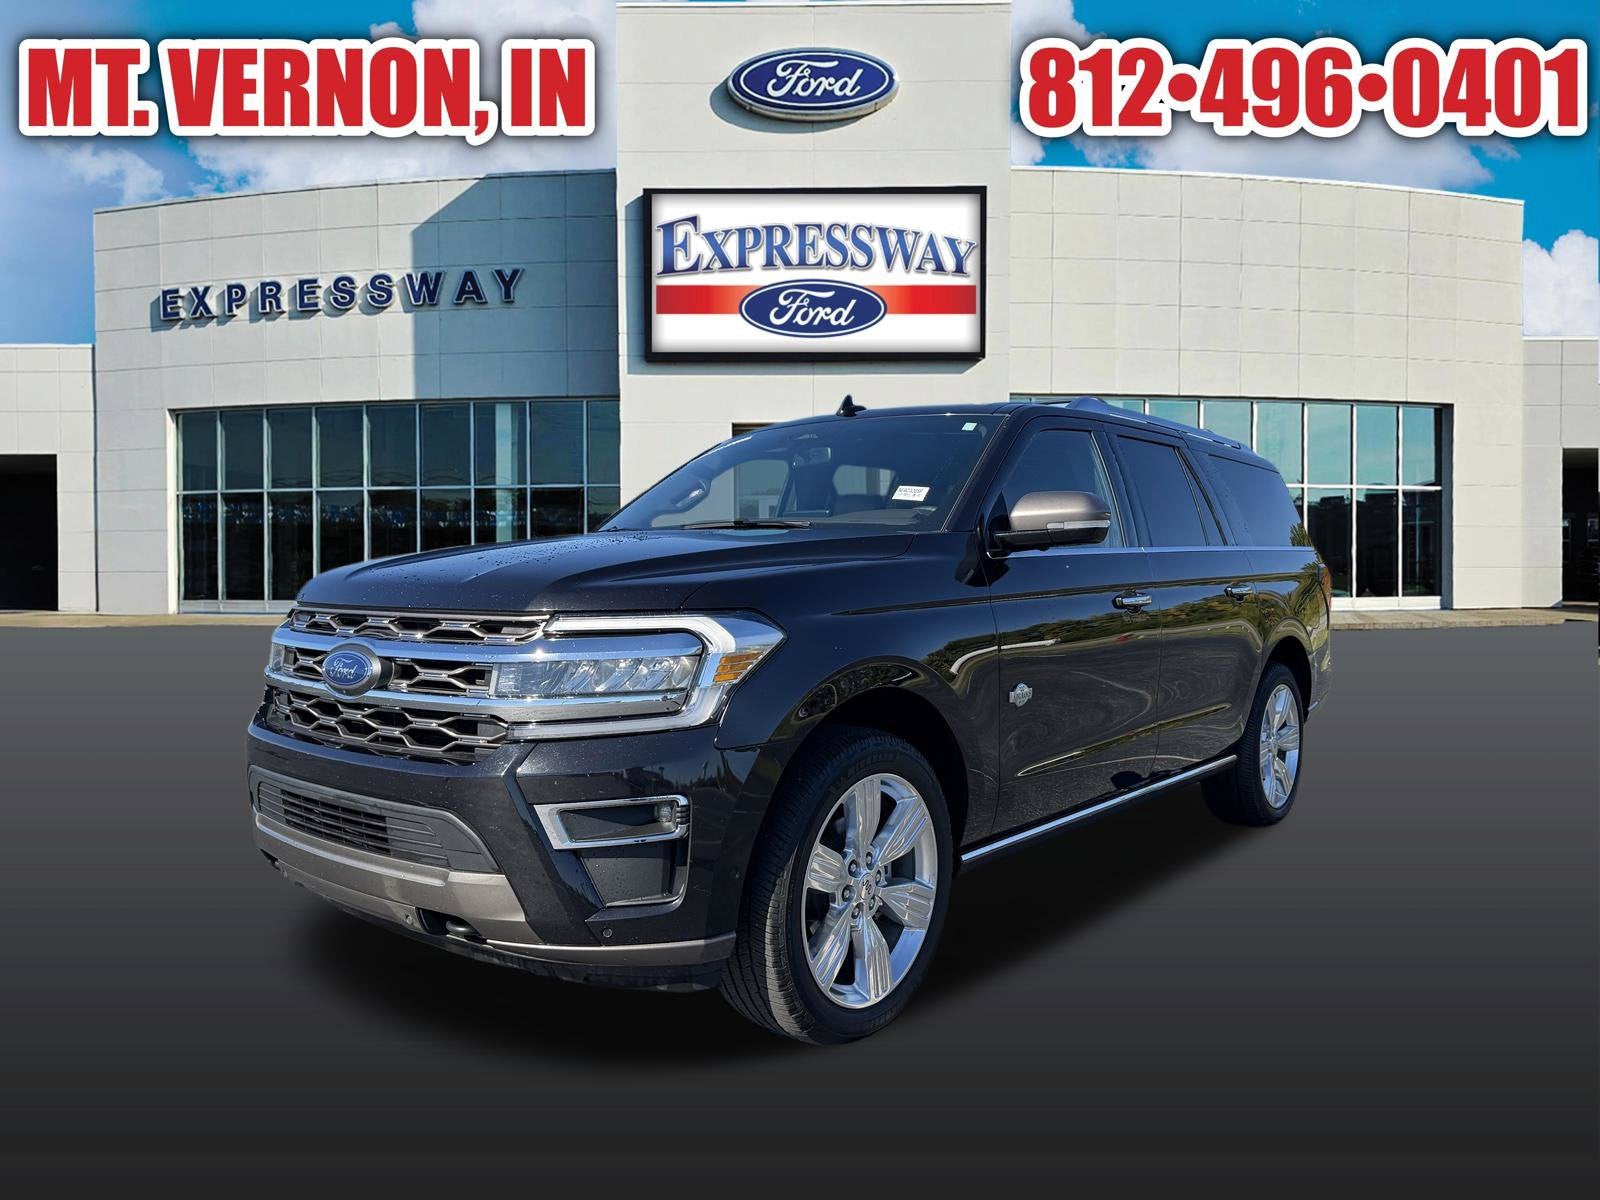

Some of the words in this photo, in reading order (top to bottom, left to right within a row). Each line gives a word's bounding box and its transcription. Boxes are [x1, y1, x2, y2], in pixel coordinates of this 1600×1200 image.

[766, 59, 865, 98] Ford
[160, 267, 526, 322] EXPRESSWAY
[768, 287, 858, 327] Ford
[329, 657, 359, 679] Ford
